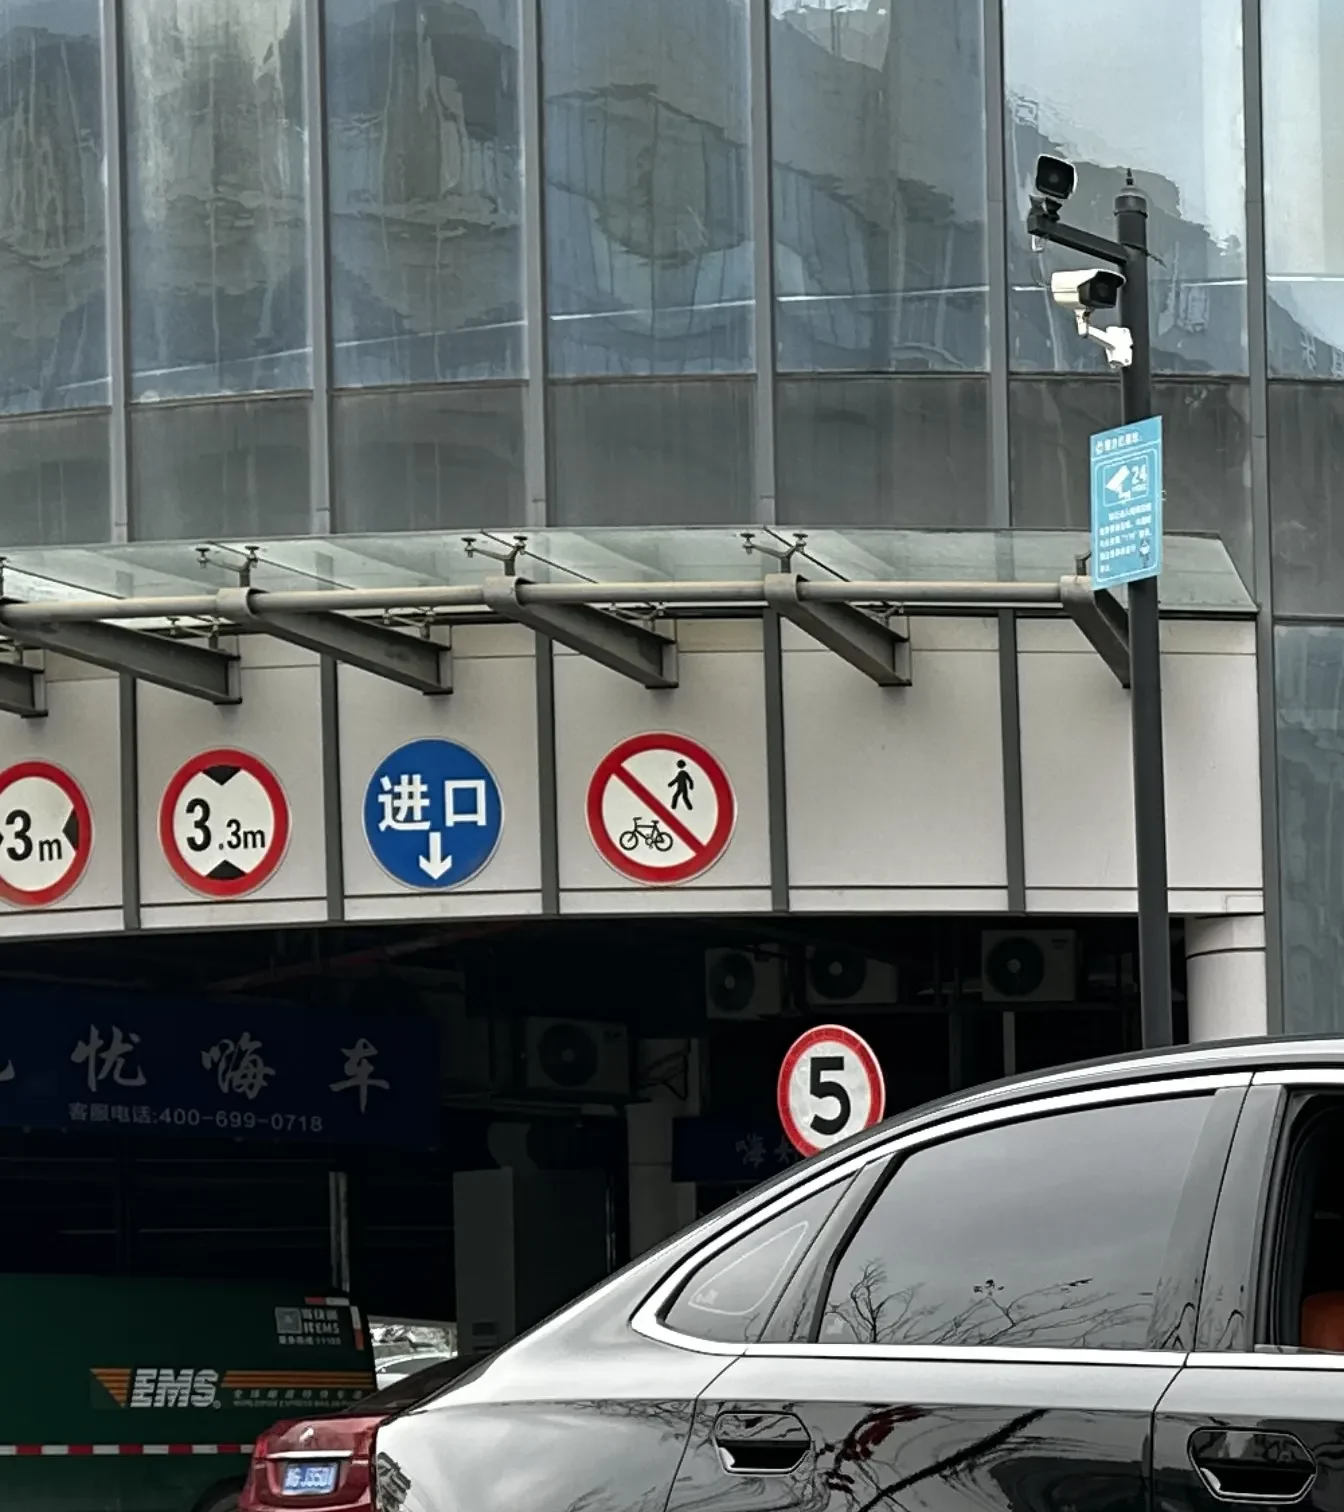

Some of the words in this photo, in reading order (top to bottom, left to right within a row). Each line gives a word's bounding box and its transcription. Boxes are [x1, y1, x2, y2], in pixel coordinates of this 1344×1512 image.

[186, 798, 266, 851] 3.3m
[378, 773, 487, 832] 进口
[6, 809, 62, 861] 3m
[0, 1023, 390, 1115] 忧嗨车
[810, 1056, 851, 1136] 5
[130, 1368, 218, 1408] EMS
